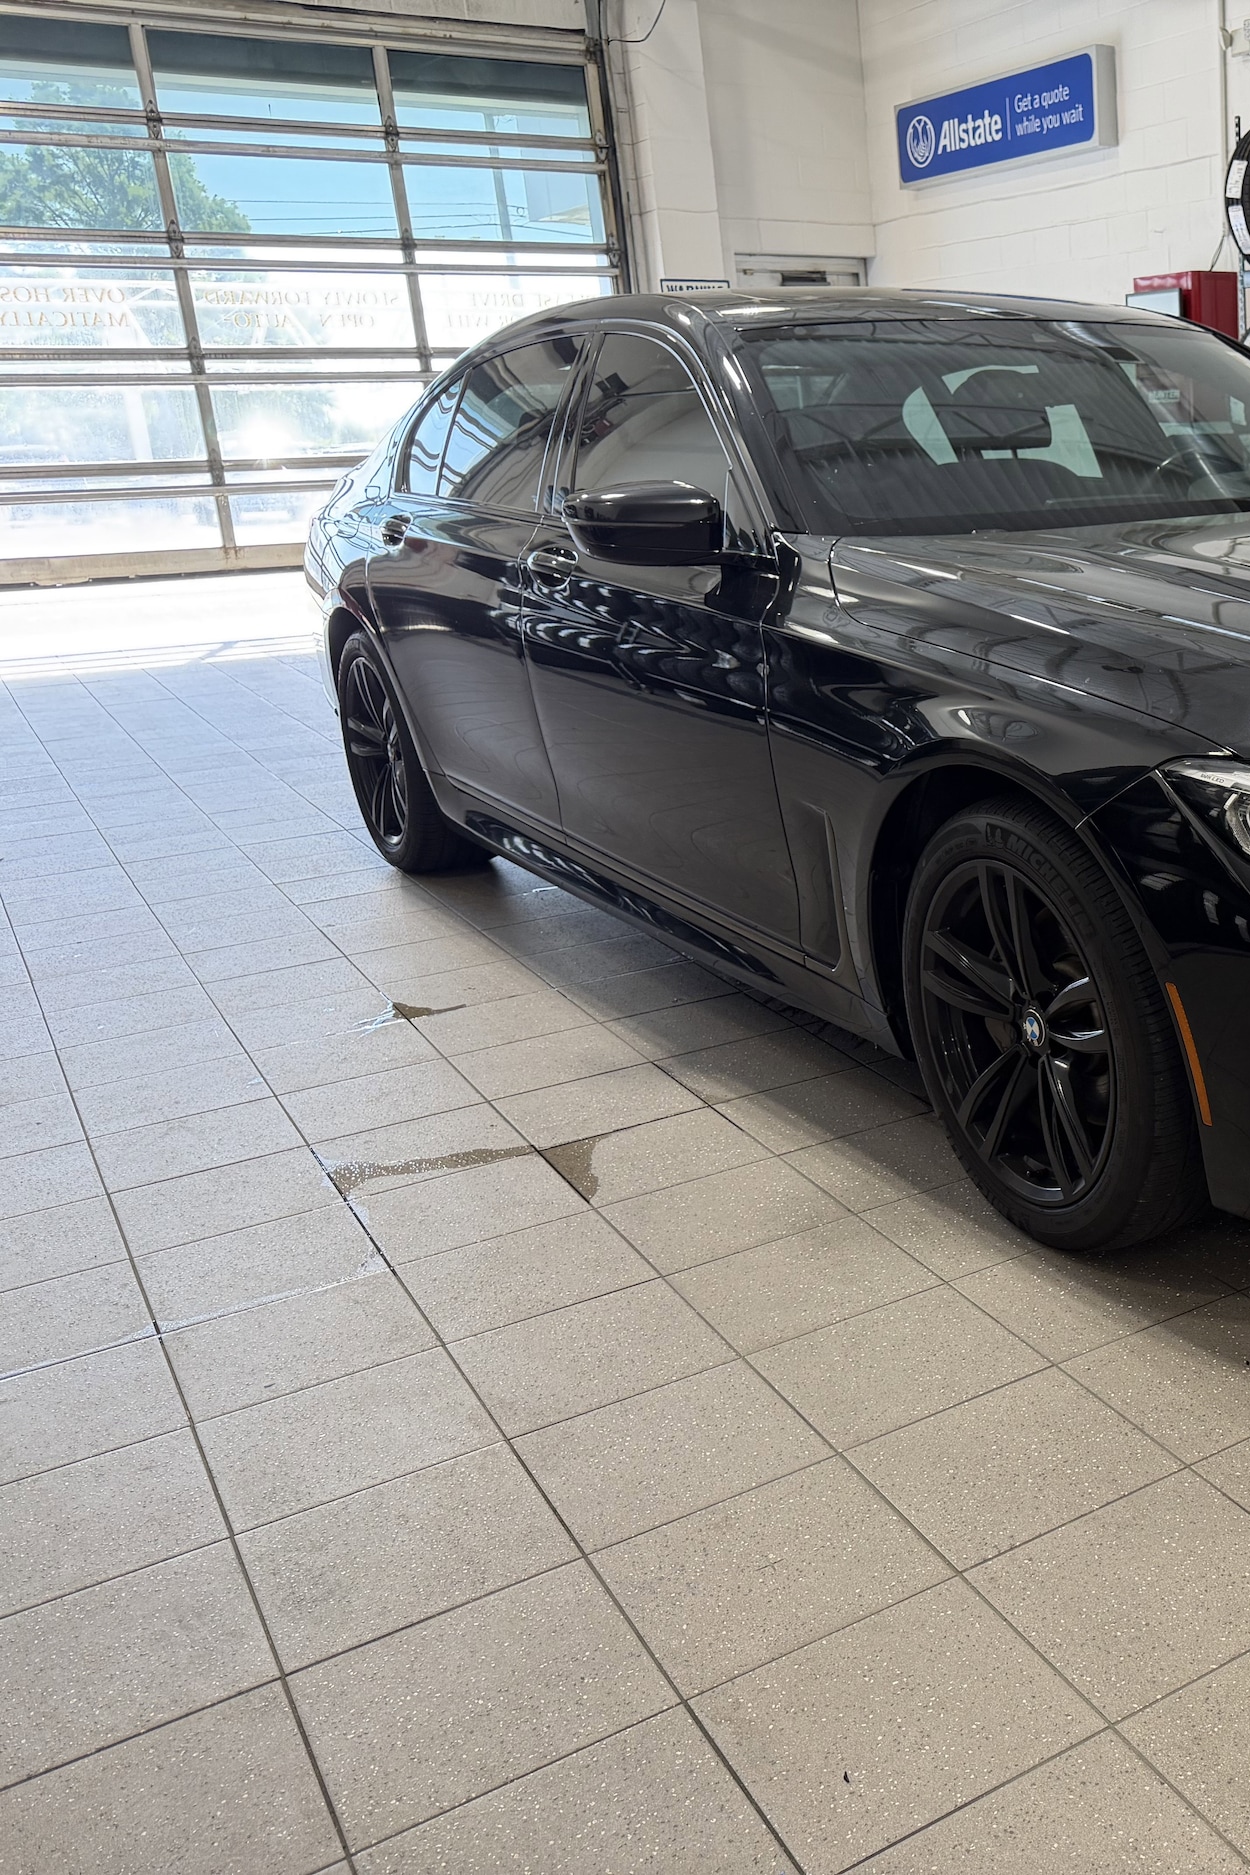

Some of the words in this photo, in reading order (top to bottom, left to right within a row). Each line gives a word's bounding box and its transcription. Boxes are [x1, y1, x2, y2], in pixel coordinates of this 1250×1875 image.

[1013, 93, 1033, 114] Get
[1033, 94, 1040, 108] a
[1041, 84, 1070, 109] quote
[937, 109, 1003, 154] Allstate
[1015, 114, 1041, 136] while
[1042, 113, 1060, 134] you
[1061, 103, 1084, 125] wait
[1006, 833, 1097, 937] MICHELIN
